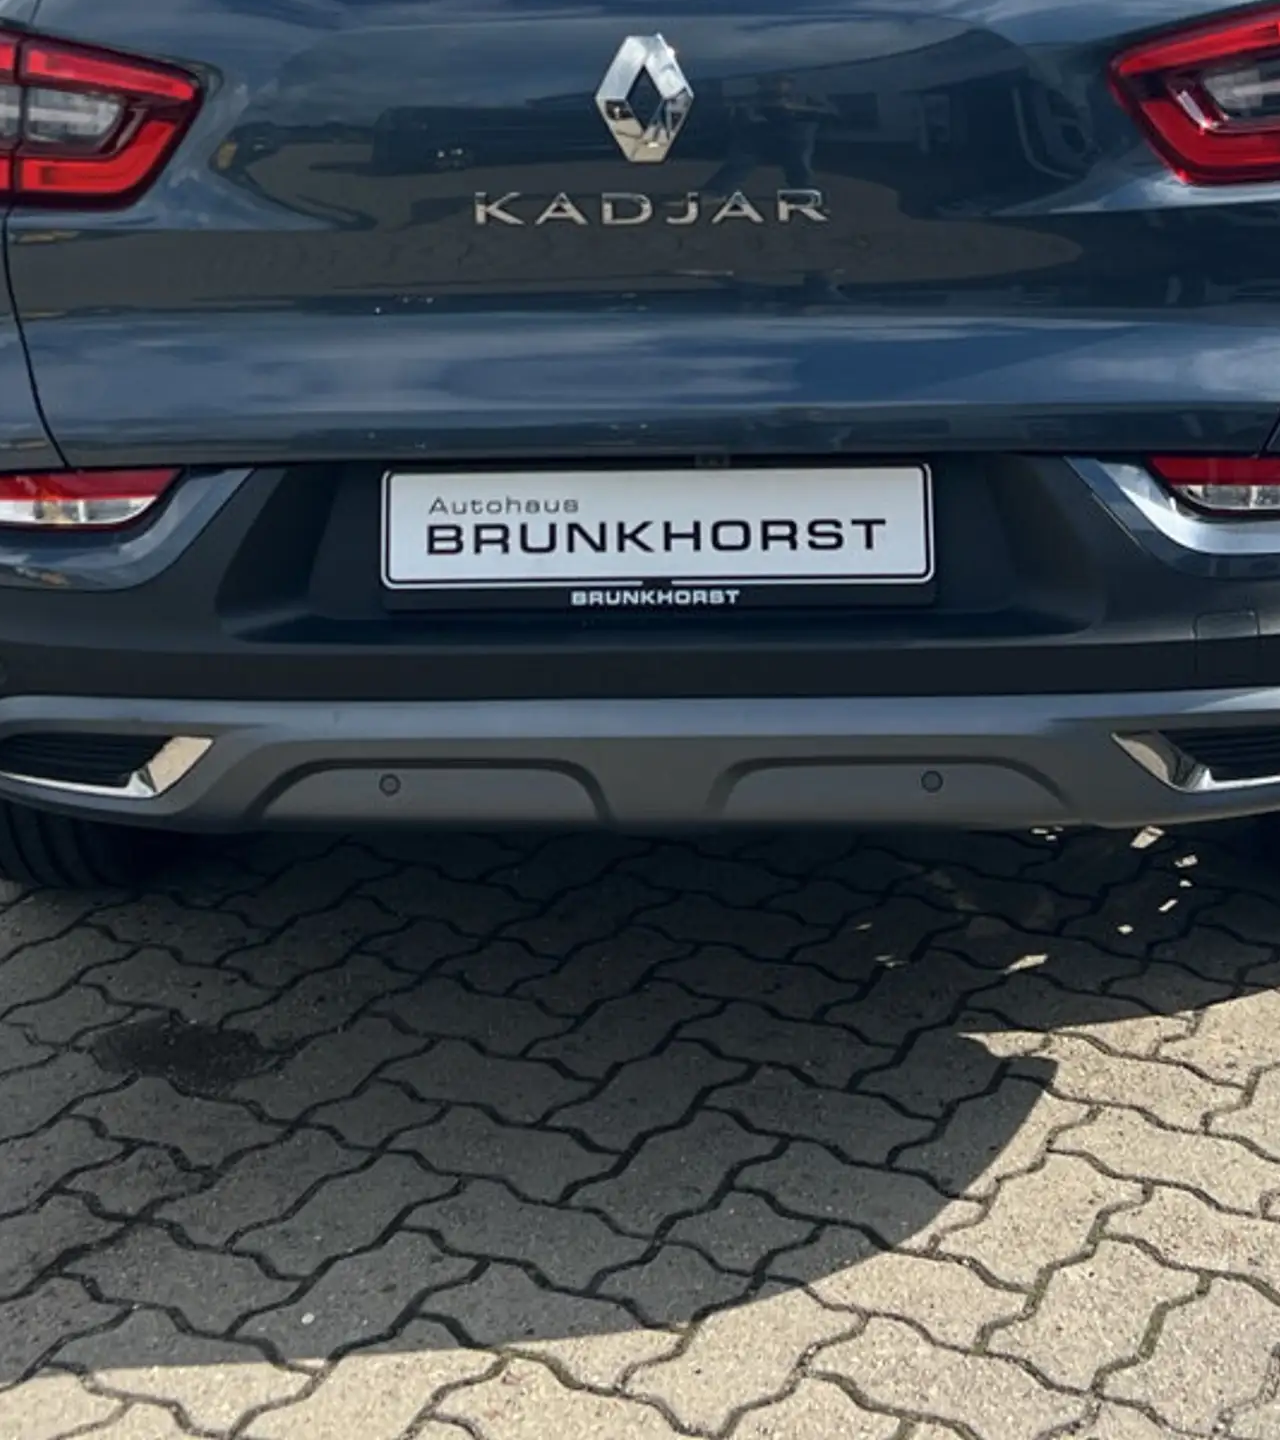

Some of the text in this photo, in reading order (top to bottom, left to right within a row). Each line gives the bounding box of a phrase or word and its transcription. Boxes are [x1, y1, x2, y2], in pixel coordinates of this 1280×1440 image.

[474, 190, 828, 225] KADJAR
[427, 496, 580, 516] Autohaus
[426, 518, 887, 556] BRUNKHORST
[570, 589, 740, 606] BRUNKHORST
